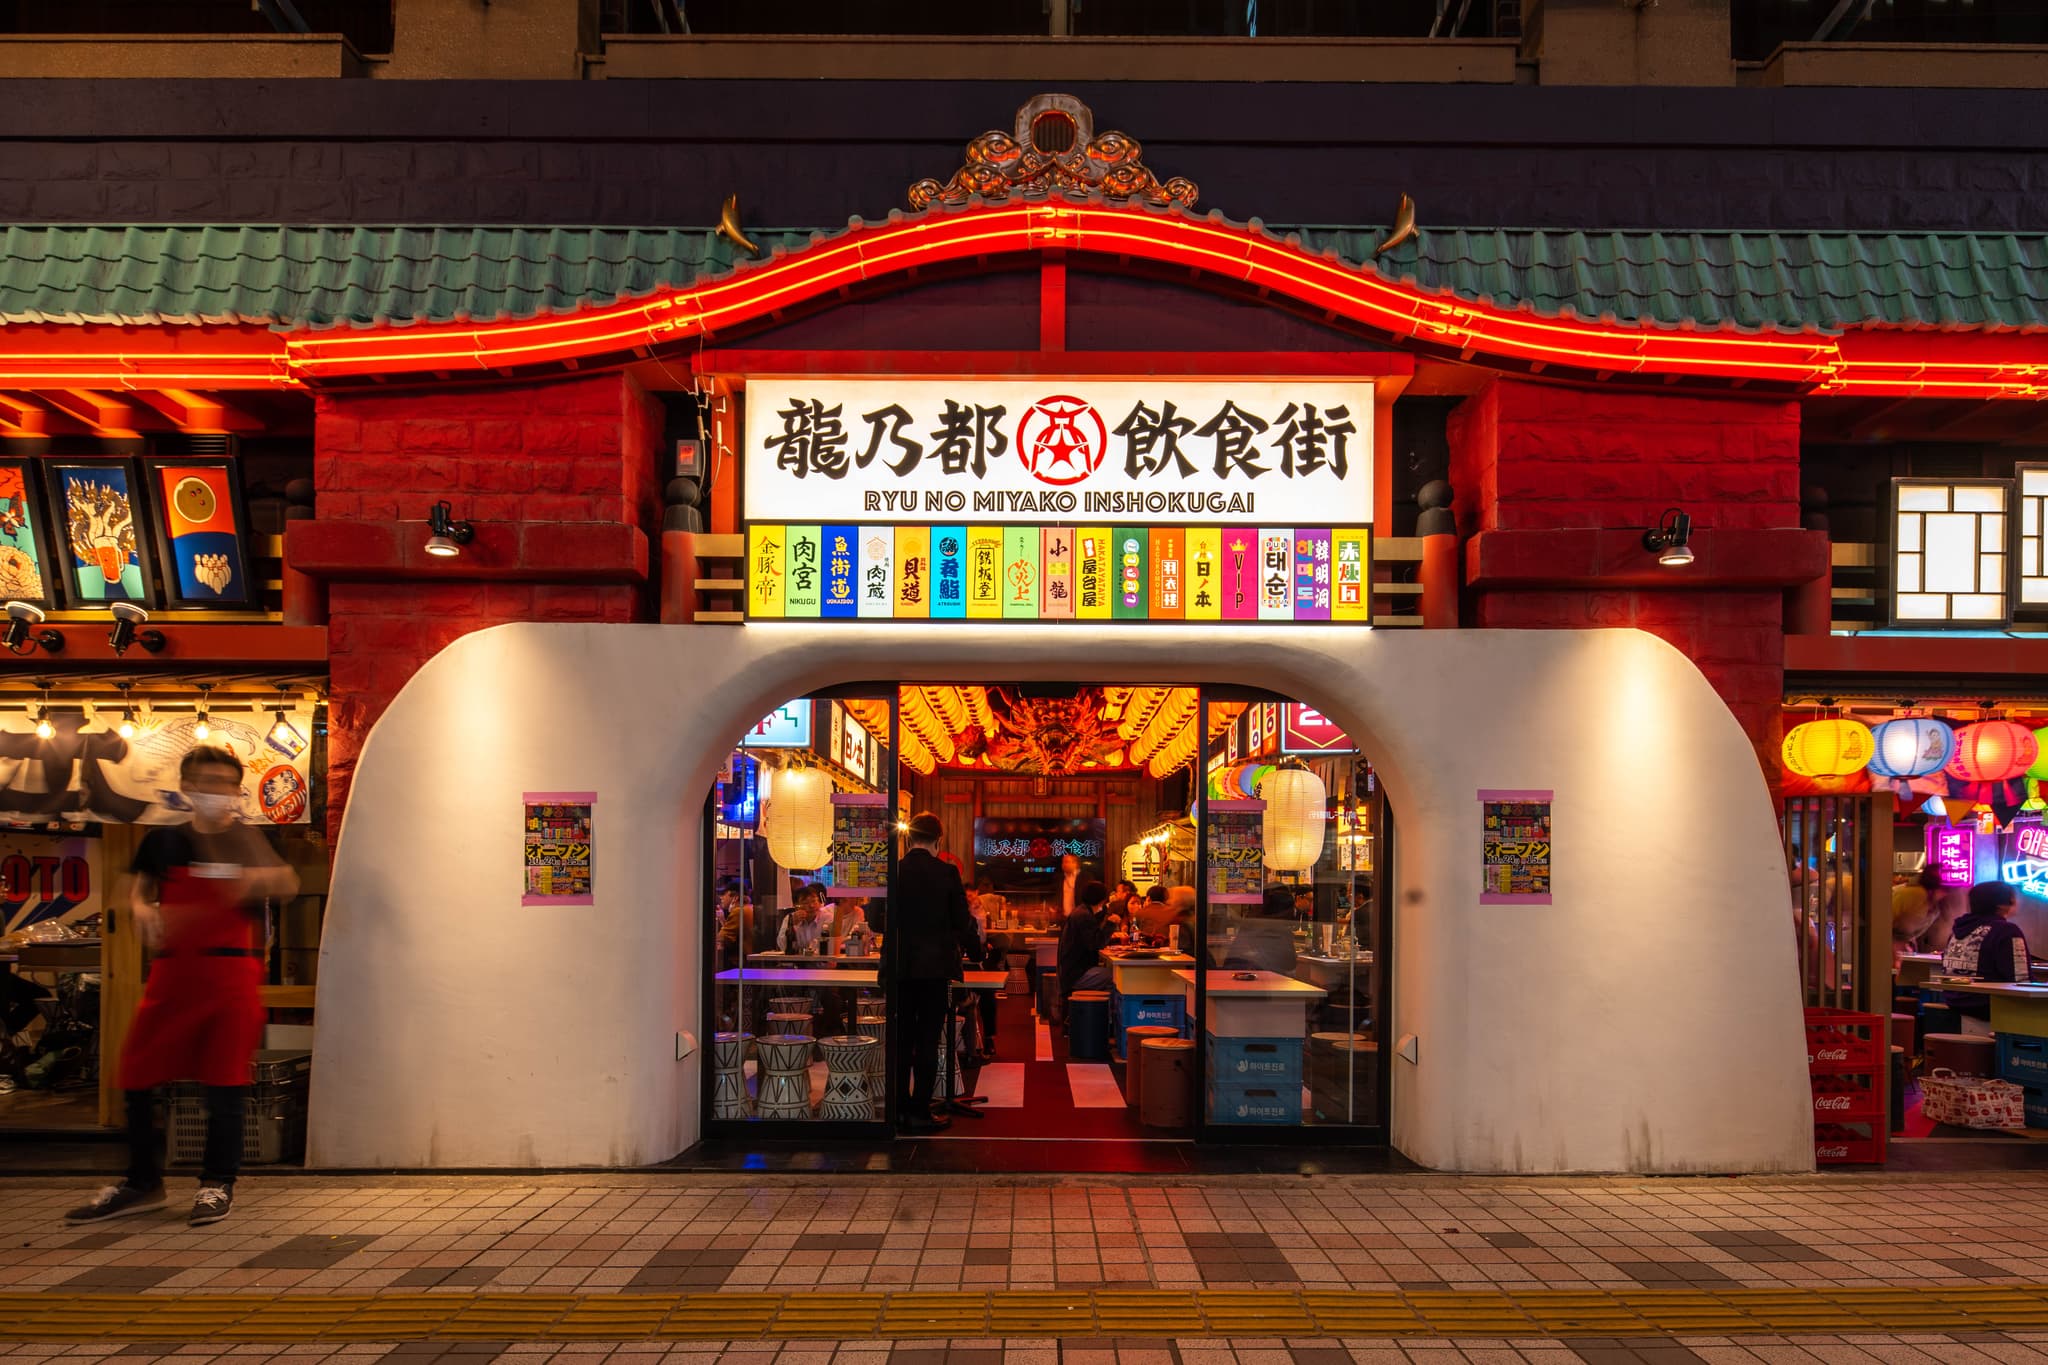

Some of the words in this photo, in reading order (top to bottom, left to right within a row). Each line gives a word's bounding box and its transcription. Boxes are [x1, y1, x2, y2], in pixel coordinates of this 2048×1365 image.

[764, 398, 1009, 478] 龍乃都
[1111, 399, 1357, 480] 飲食街
[864, 491, 918, 512] RYU
[926, 491, 966, 512] NO
[973, 491, 1077, 512] MIYAKO
[1085, 492, 1255, 513] INSHOKUGAI
[791, 536, 817, 591] 肉宮
[830, 535, 851, 598] 魚街道
[866, 564, 886, 599] 肉蔵
[901, 557, 922, 604] 貝道
[1195, 561, 1212, 608] 日ノ本
[1234, 553, 1244, 609] VIP
[1265, 551, 1287, 596] 태순
[1296, 539, 1314, 609] 한명동
[1315, 539, 1329, 609] 韓明洞
[526, 843, 590, 859] オープン
[1485, 841, 1550, 858] オープン
